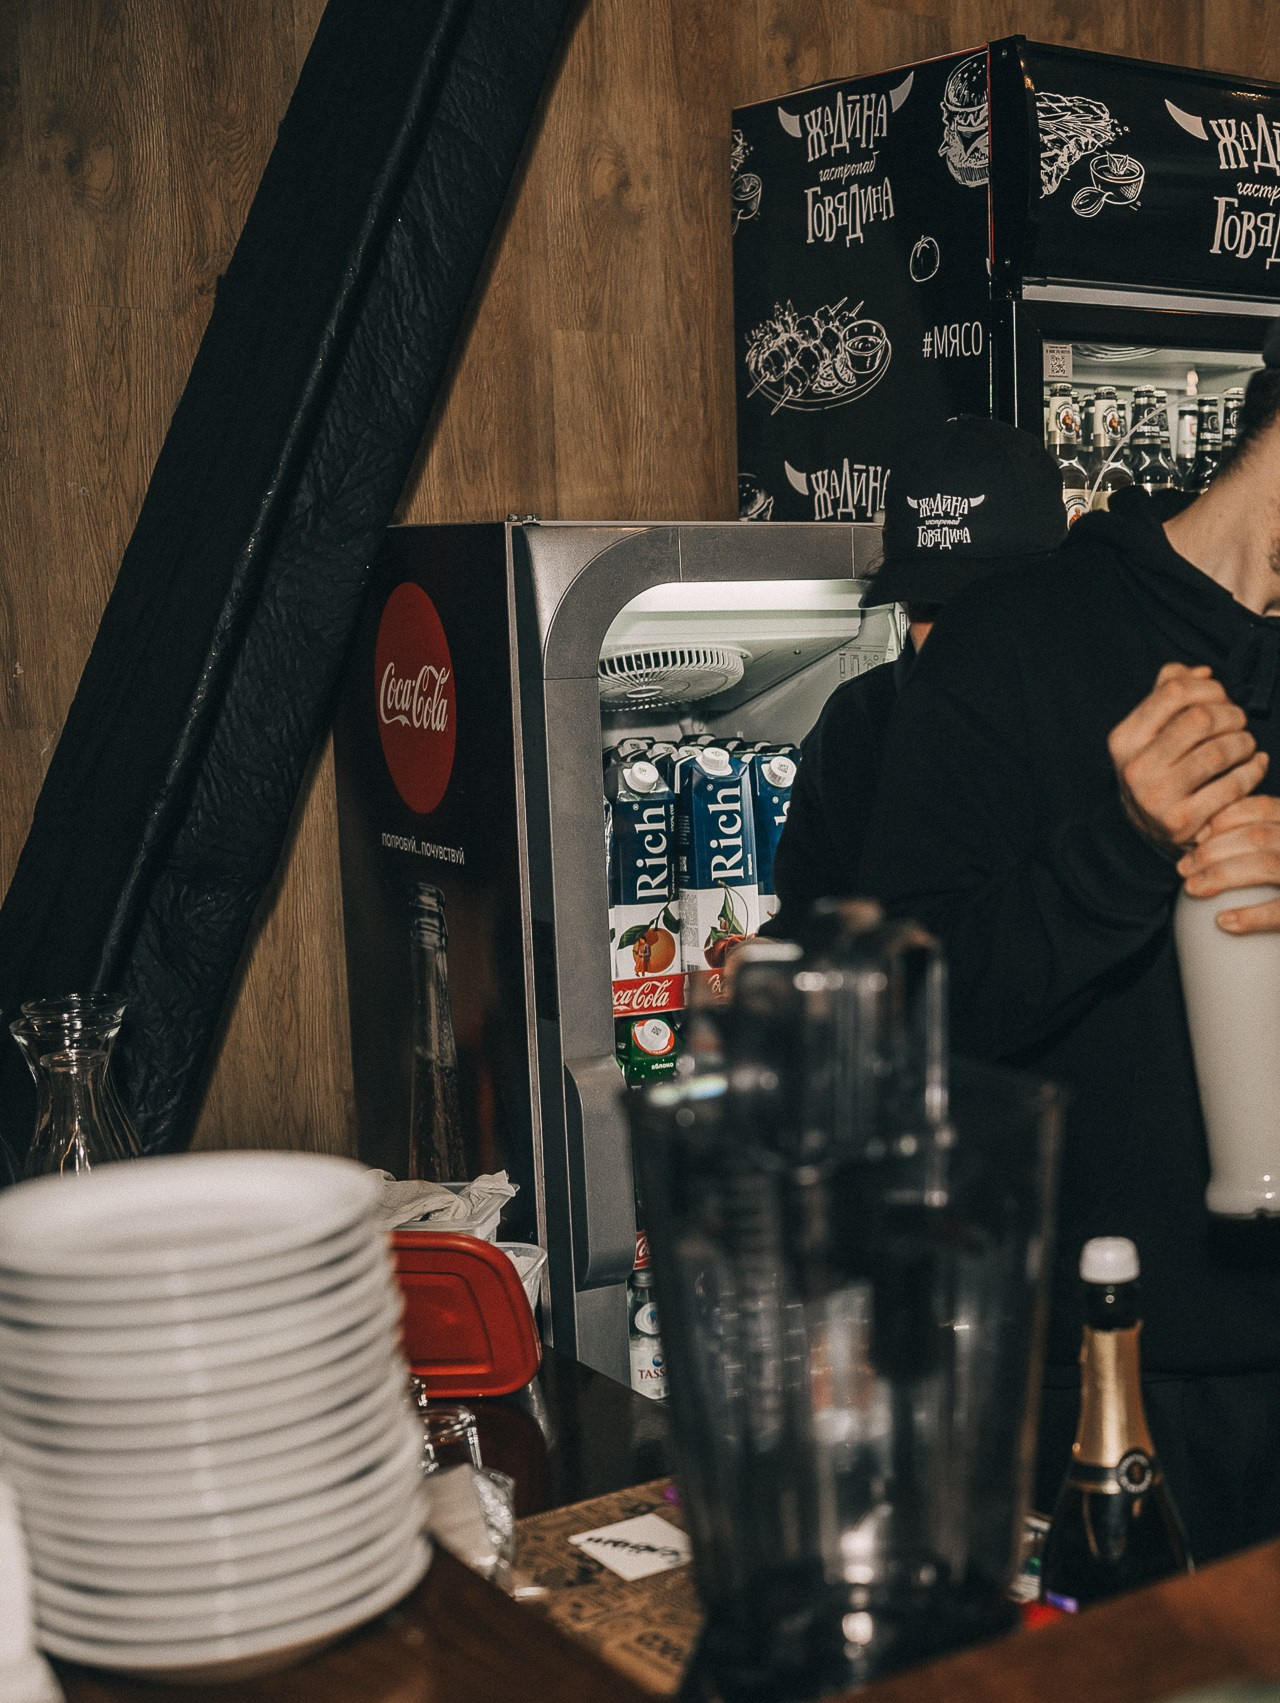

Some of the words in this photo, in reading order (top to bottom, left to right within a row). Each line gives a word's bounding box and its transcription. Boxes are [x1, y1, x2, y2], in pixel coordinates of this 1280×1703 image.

[818, 150, 880, 185] гастропаб
[922, 321, 983, 359] #МЯСО
[380, 662, 450, 732] Coca-Cola
[634, 804, 669, 900] Rich
[707, 785, 744, 882] Rich
[612, 979, 673, 1009] ca-Cola
